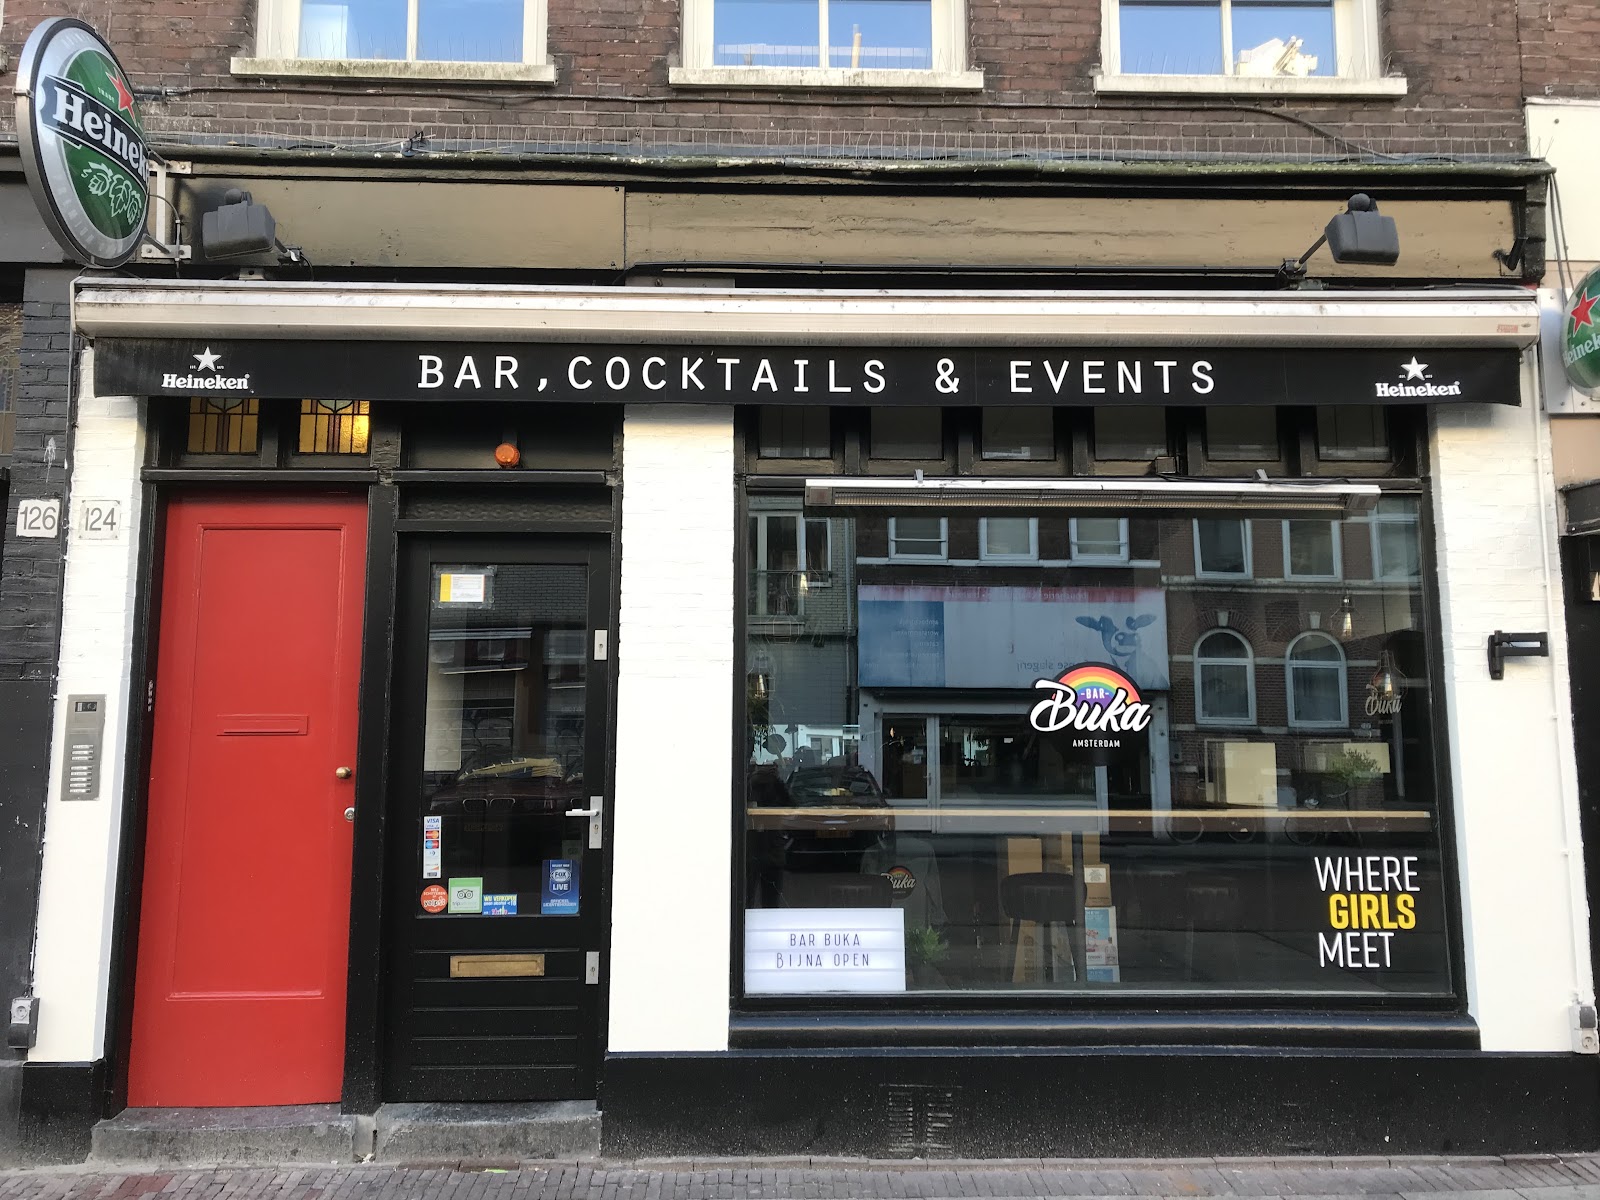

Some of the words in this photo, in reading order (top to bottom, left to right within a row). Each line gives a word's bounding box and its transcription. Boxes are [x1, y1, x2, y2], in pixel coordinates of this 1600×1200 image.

[161, 373, 251, 391] Heineken
[935, 358, 960, 394] &
[1010, 360, 1215, 394] EVENTS
[1374, 380, 1462, 397] Heineken
[20, 506, 56, 531] 126
[84, 507, 117, 532] 124
[1029, 679, 1152, 733] Buka
[1072, 738, 1121, 748] AMSTERDAM
[1314, 856, 1421, 892] WHERE
[552, 883, 569, 891] LIVE
[1329, 893, 1416, 930] GIRLS
[789, 933, 816, 947] BAR
[823, 933, 861, 947] BUKA
[1318, 931, 1395, 968] MEET
[776, 952, 823, 969] BIJNA
[833, 953, 870, 967] OPEN
